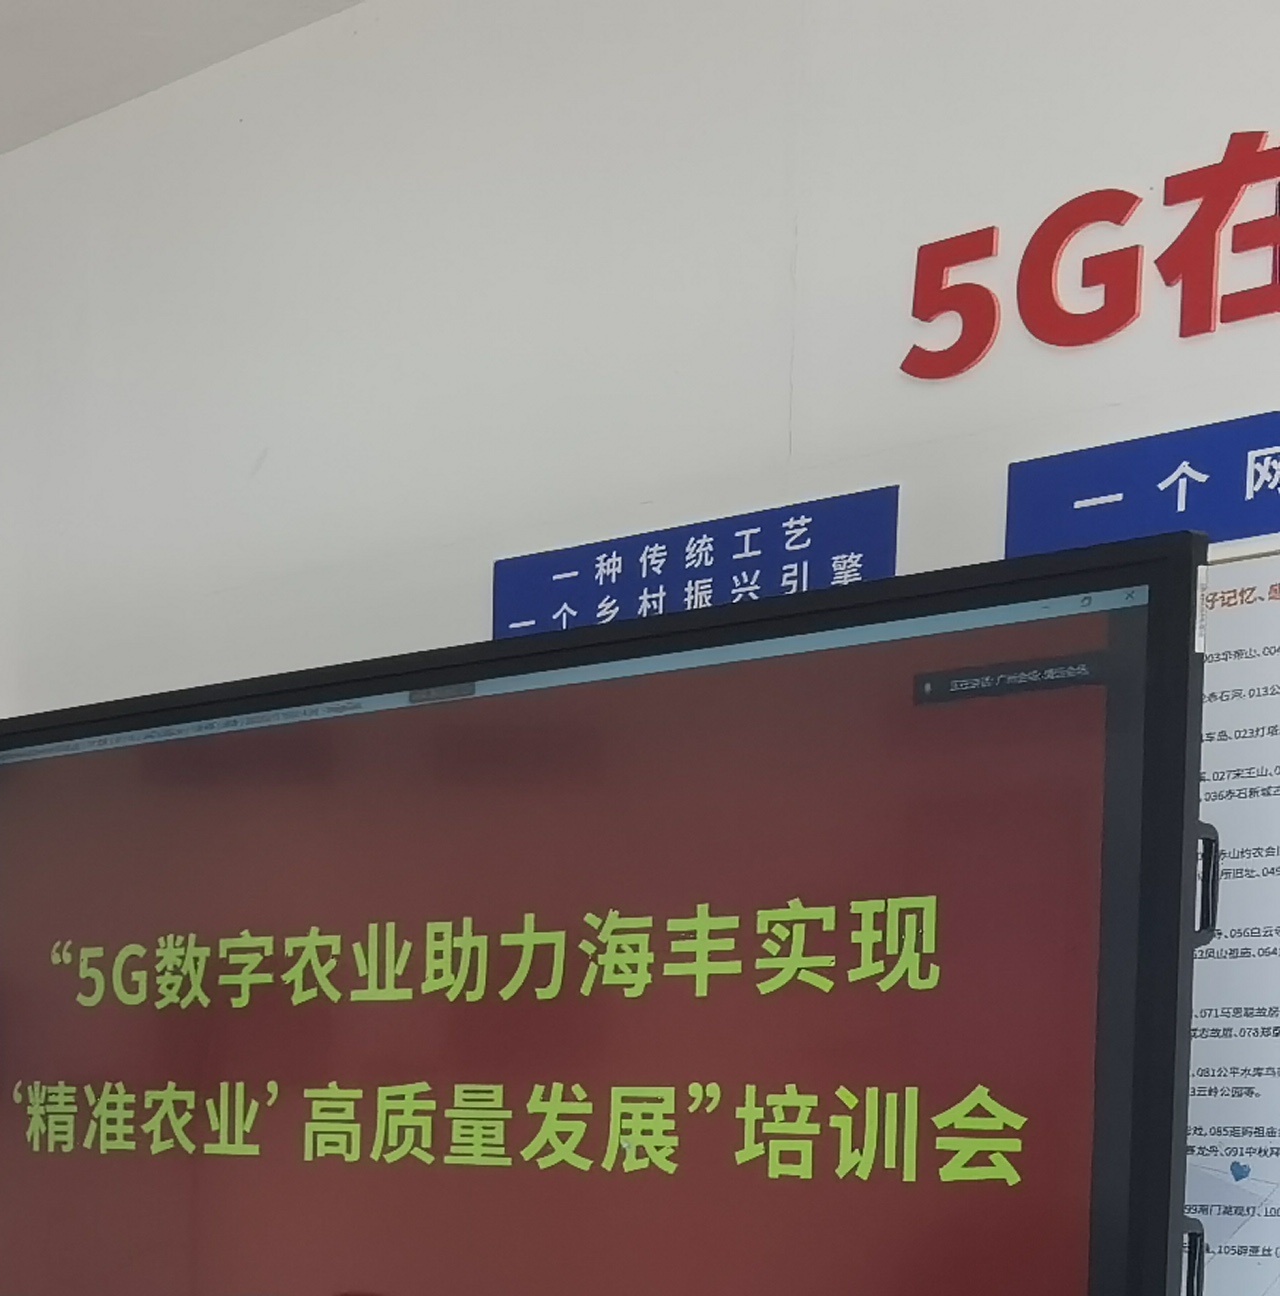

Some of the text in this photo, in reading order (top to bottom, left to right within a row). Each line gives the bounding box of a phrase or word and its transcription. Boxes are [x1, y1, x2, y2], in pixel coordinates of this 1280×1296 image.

[900, 130, 1280, 380] 5G在
[508, 552, 864, 632] 一个乡村振兴引擎
[552, 515, 813, 587] 一种传统工艺
[49, 895, 942, 1011] “5G数字农业助力海丰实现
